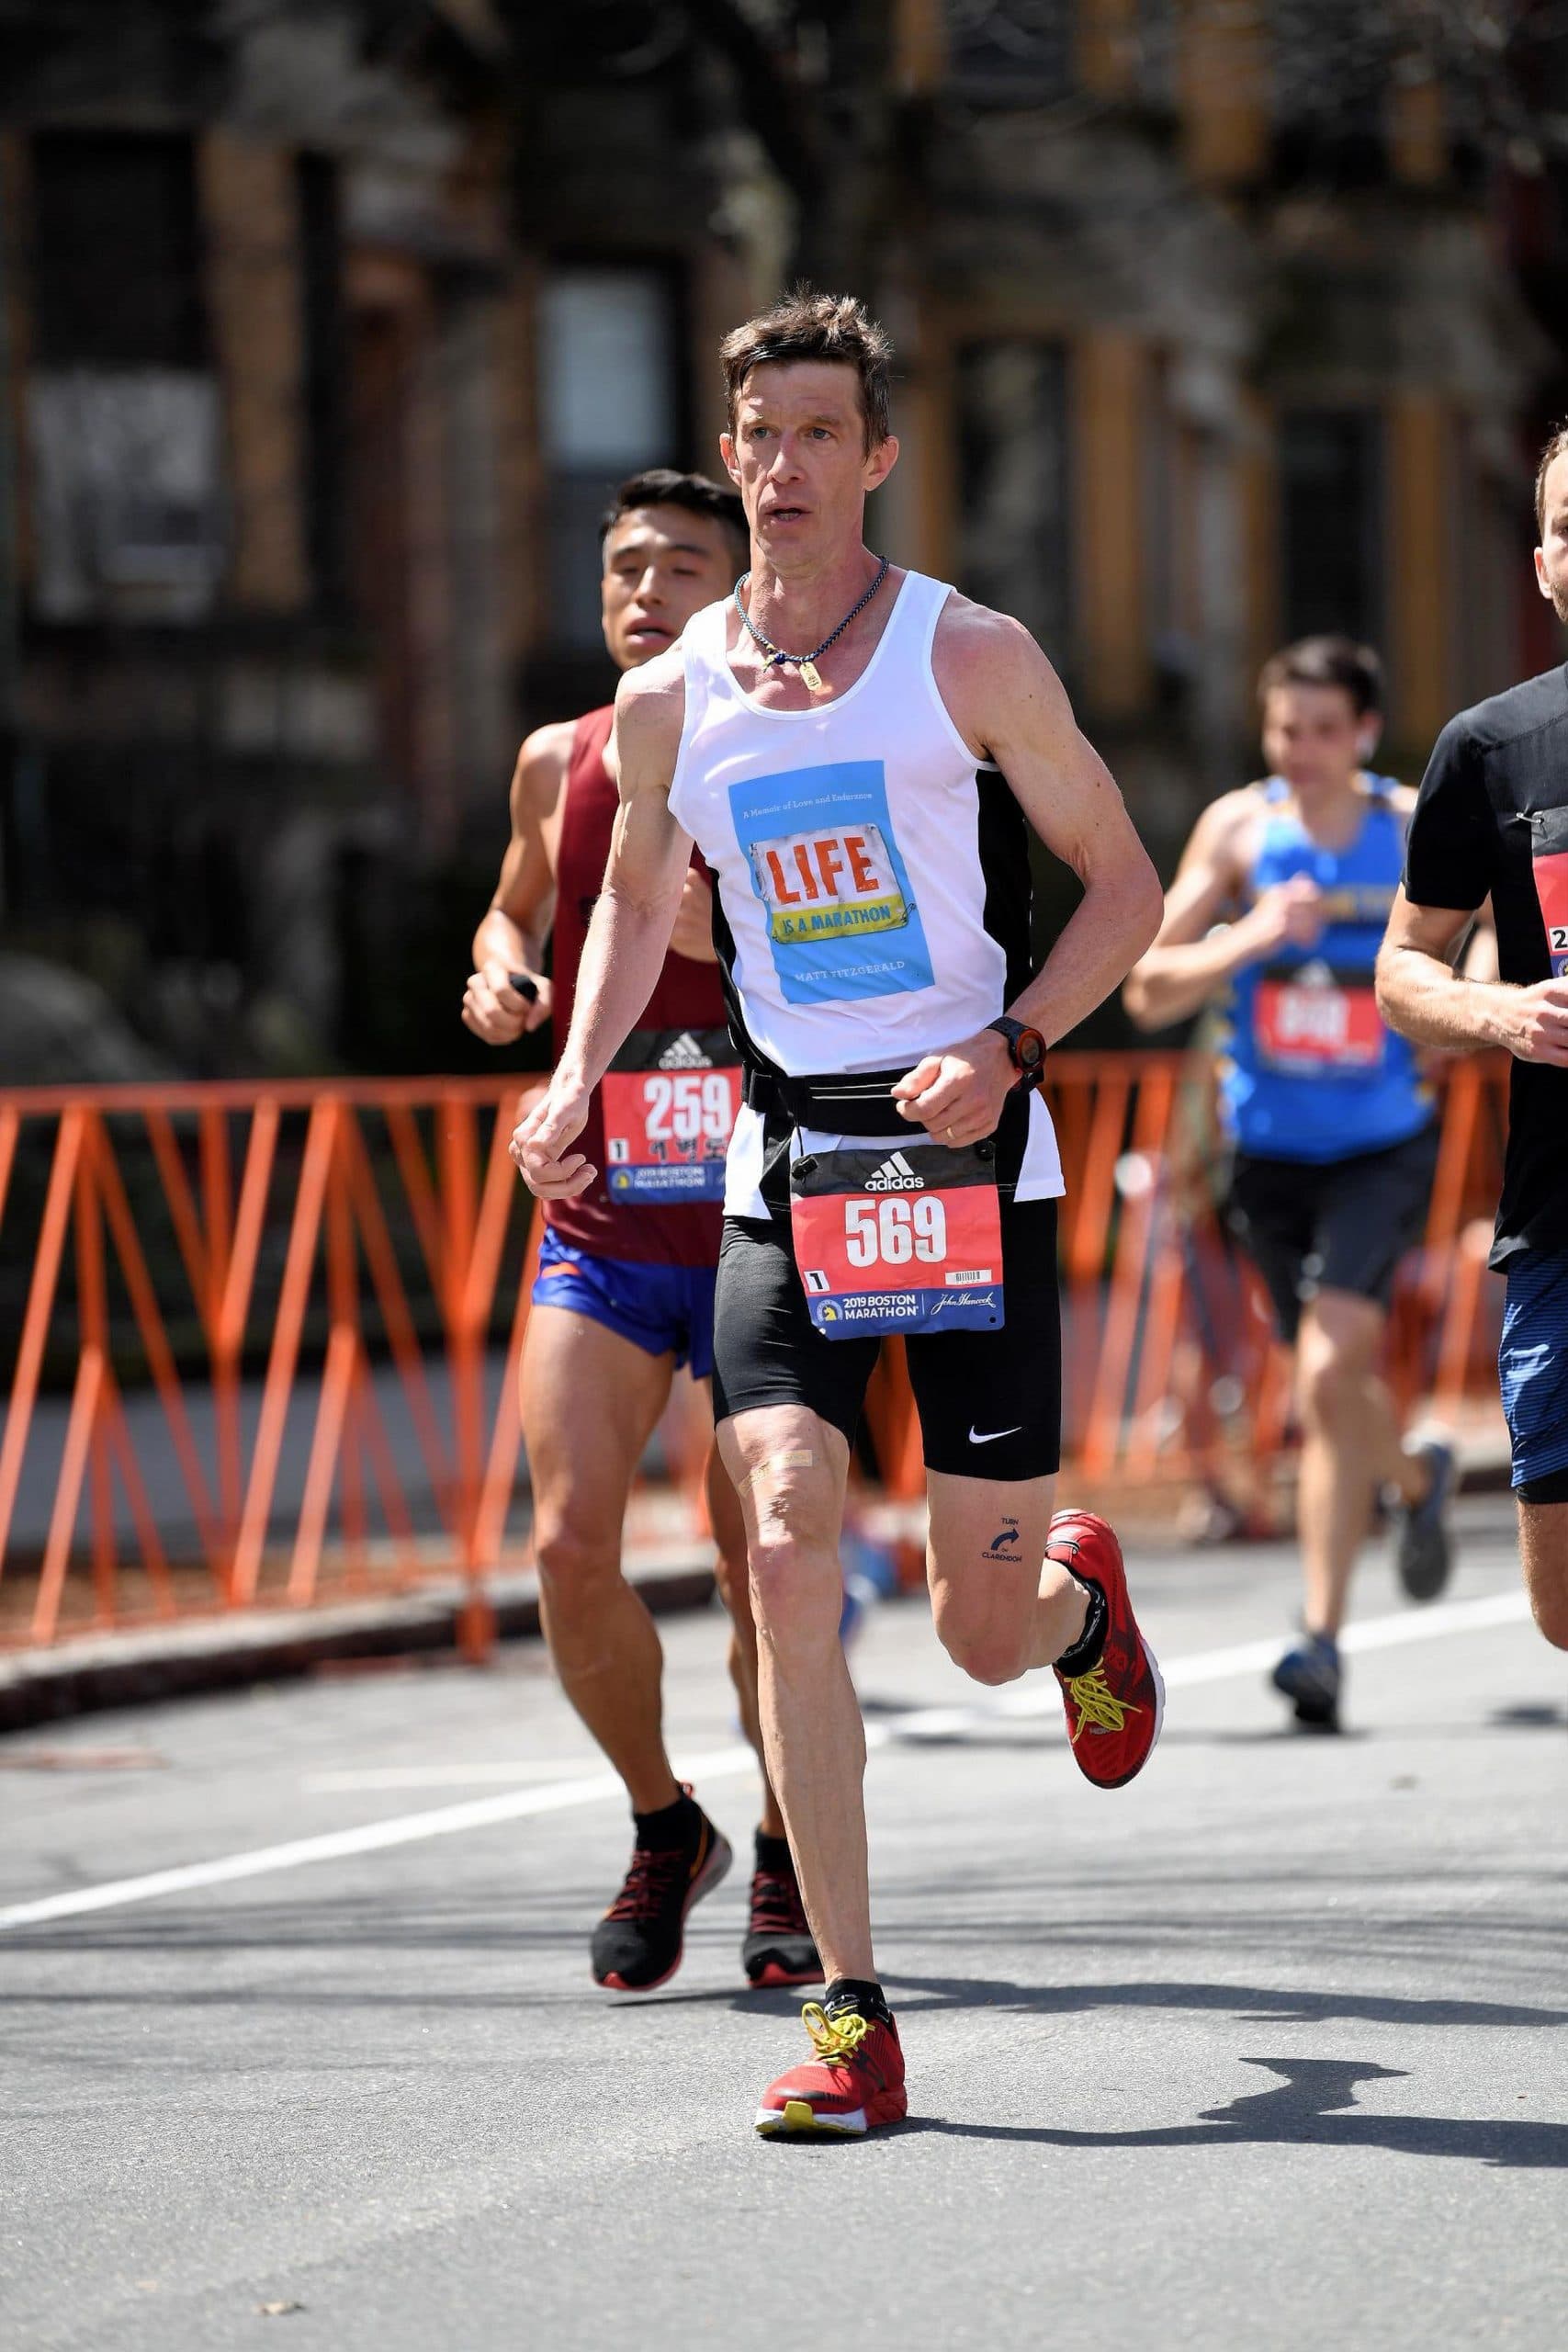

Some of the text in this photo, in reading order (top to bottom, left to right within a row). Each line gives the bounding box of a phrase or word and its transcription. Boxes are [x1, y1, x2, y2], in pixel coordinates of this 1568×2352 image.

[743, 793, 872, 820] A Memoir of Love and Endurance
[766, 837, 879, 905] LIFE
[783, 906, 890, 935] IS A MARATHON
[1552, 930, 1567, 948] 2
[795, 961, 905, 982] MATT FITZGERALD
[645, 1074, 731, 1139] 259
[615, 1141, 622, 1159] 1
[864, 1176, 925, 1192] adidas
[845, 1196, 947, 1267] 569
[809, 1272, 824, 1290] 1
[842, 1296, 867, 1308] 2019
[868, 1295, 916, 1306] BOSTON
[931, 1292, 997, 1315] John Hancock
[844, 1306, 919, 1320] MARATHON
[982, 1552, 1021, 1562] CLARENDON
